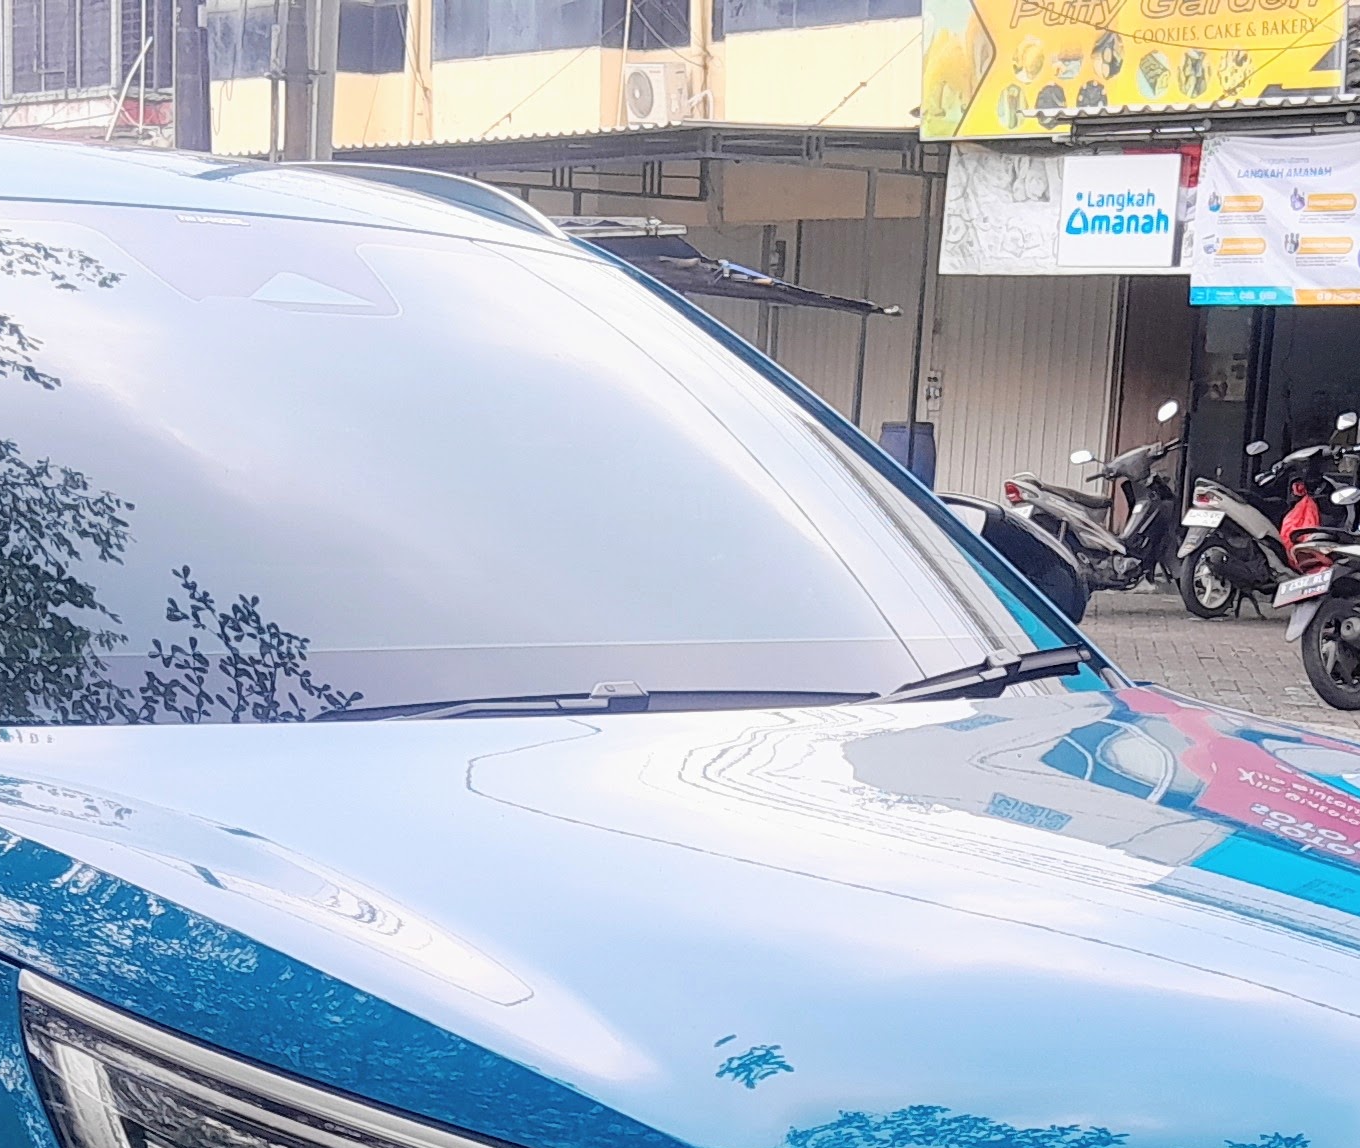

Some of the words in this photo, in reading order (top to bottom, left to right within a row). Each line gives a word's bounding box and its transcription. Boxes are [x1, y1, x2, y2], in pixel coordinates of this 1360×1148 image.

[1009, 0, 1128, 30] Puffy
[1204, 22, 1241, 41] CAKE
[1246, 21, 1257, 37] &
[1261, 17, 1319, 36] BAKERY
[1087, 188, 1156, 212] Langkah
